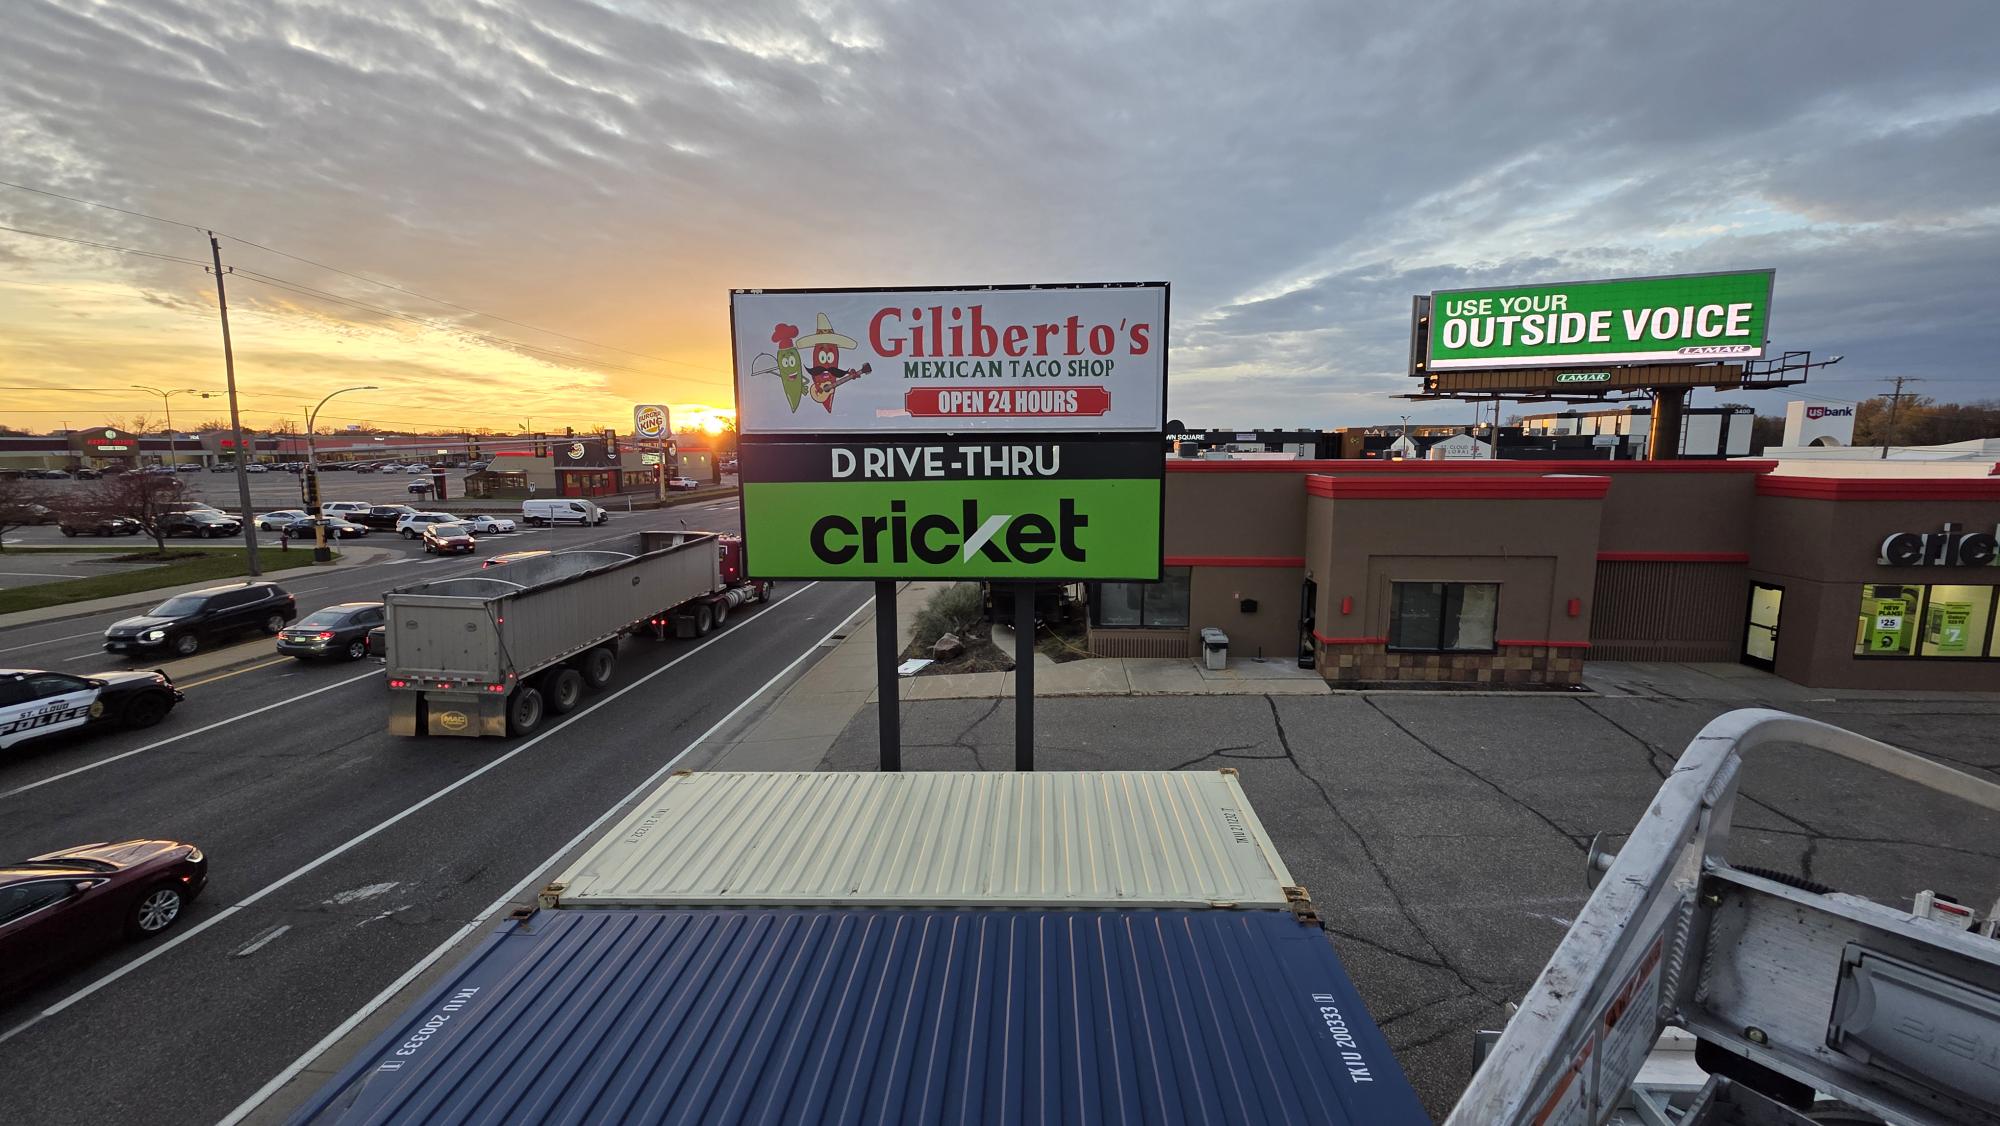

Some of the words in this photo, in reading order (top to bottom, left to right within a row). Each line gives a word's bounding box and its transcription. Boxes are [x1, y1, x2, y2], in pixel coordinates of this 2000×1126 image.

[1446, 299, 1493, 317] USE
[1499, 294, 1568, 314] YOUR
[868, 304, 1151, 358] Giliberto's
[1442, 310, 1613, 349] OUTSIDE
[1622, 302, 1753, 341] VOICE
[1682, 346, 1746, 355] LAMAR
[903, 360, 1003, 379] MEXICAN
[1008, 360, 1062, 378] TACO
[1068, 359, 1115, 377] SHOP
[1560, 372, 1606, 382] LAMAR
[938, 390, 986, 414] OPEN
[987, 390, 1011, 413] 24
[1015, 389, 1078, 413] HOURS
[639, 411, 661, 422] BURGER
[640, 417, 663, 430] KING
[809, 498, 1089, 565] cricket
[1881, 522, 2000, 567] cric
[1881, 619, 1896, 627] $25
[0, 706, 90, 736] POLICE
[19, 711, 35, 720] ST.
[38, 703, 70, 715] CLOUD
[442, 986, 481, 1012] TKIU
[395, 1014, 451, 1057] 200333
[1319, 1006, 1358, 1049] 200333
[1340, 1051, 1374, 1084] TKIU
